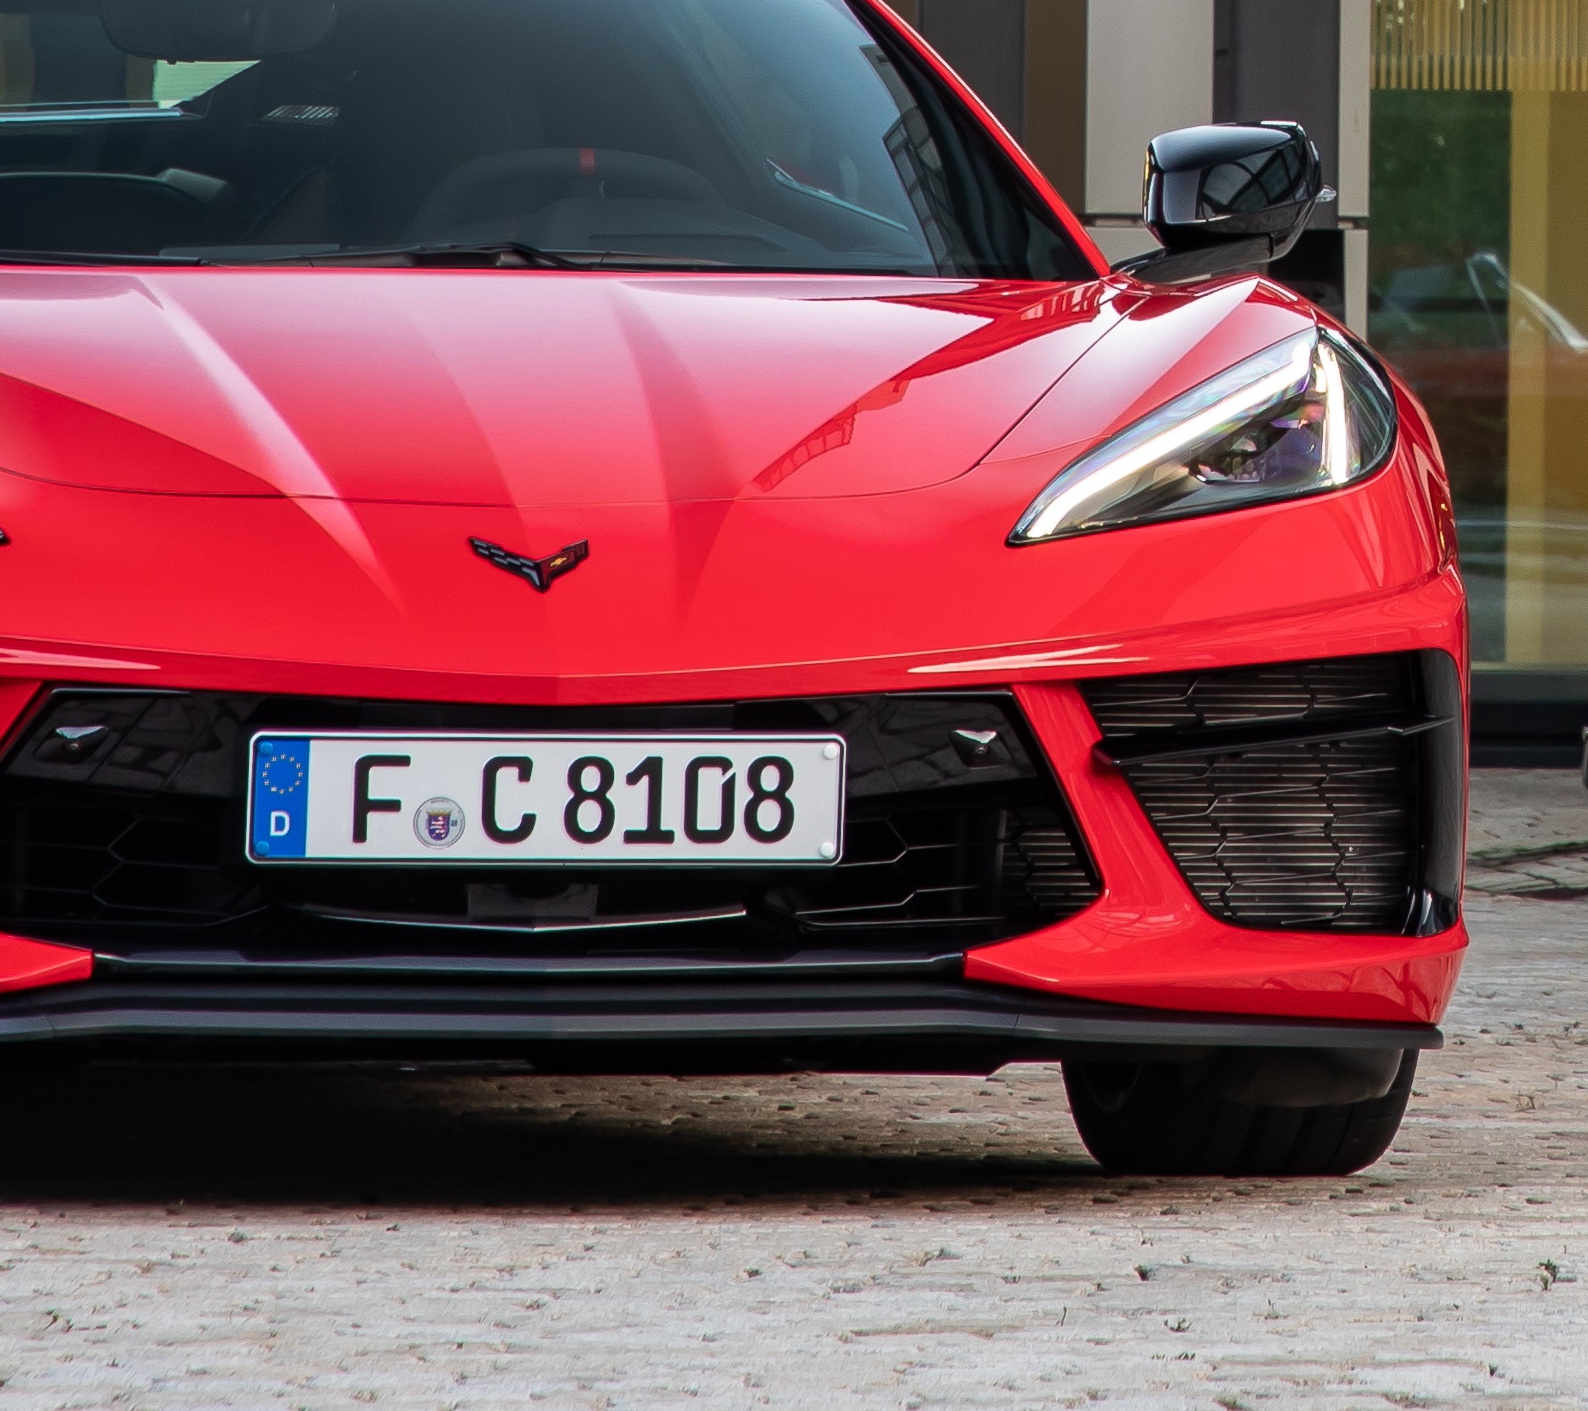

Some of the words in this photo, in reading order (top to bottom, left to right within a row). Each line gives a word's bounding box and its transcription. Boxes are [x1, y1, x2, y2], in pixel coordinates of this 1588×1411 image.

[269, 811, 291, 837] D
[351, 754, 412, 844] F
[481, 755, 537, 845] C
[563, 755, 795, 845] 8108
